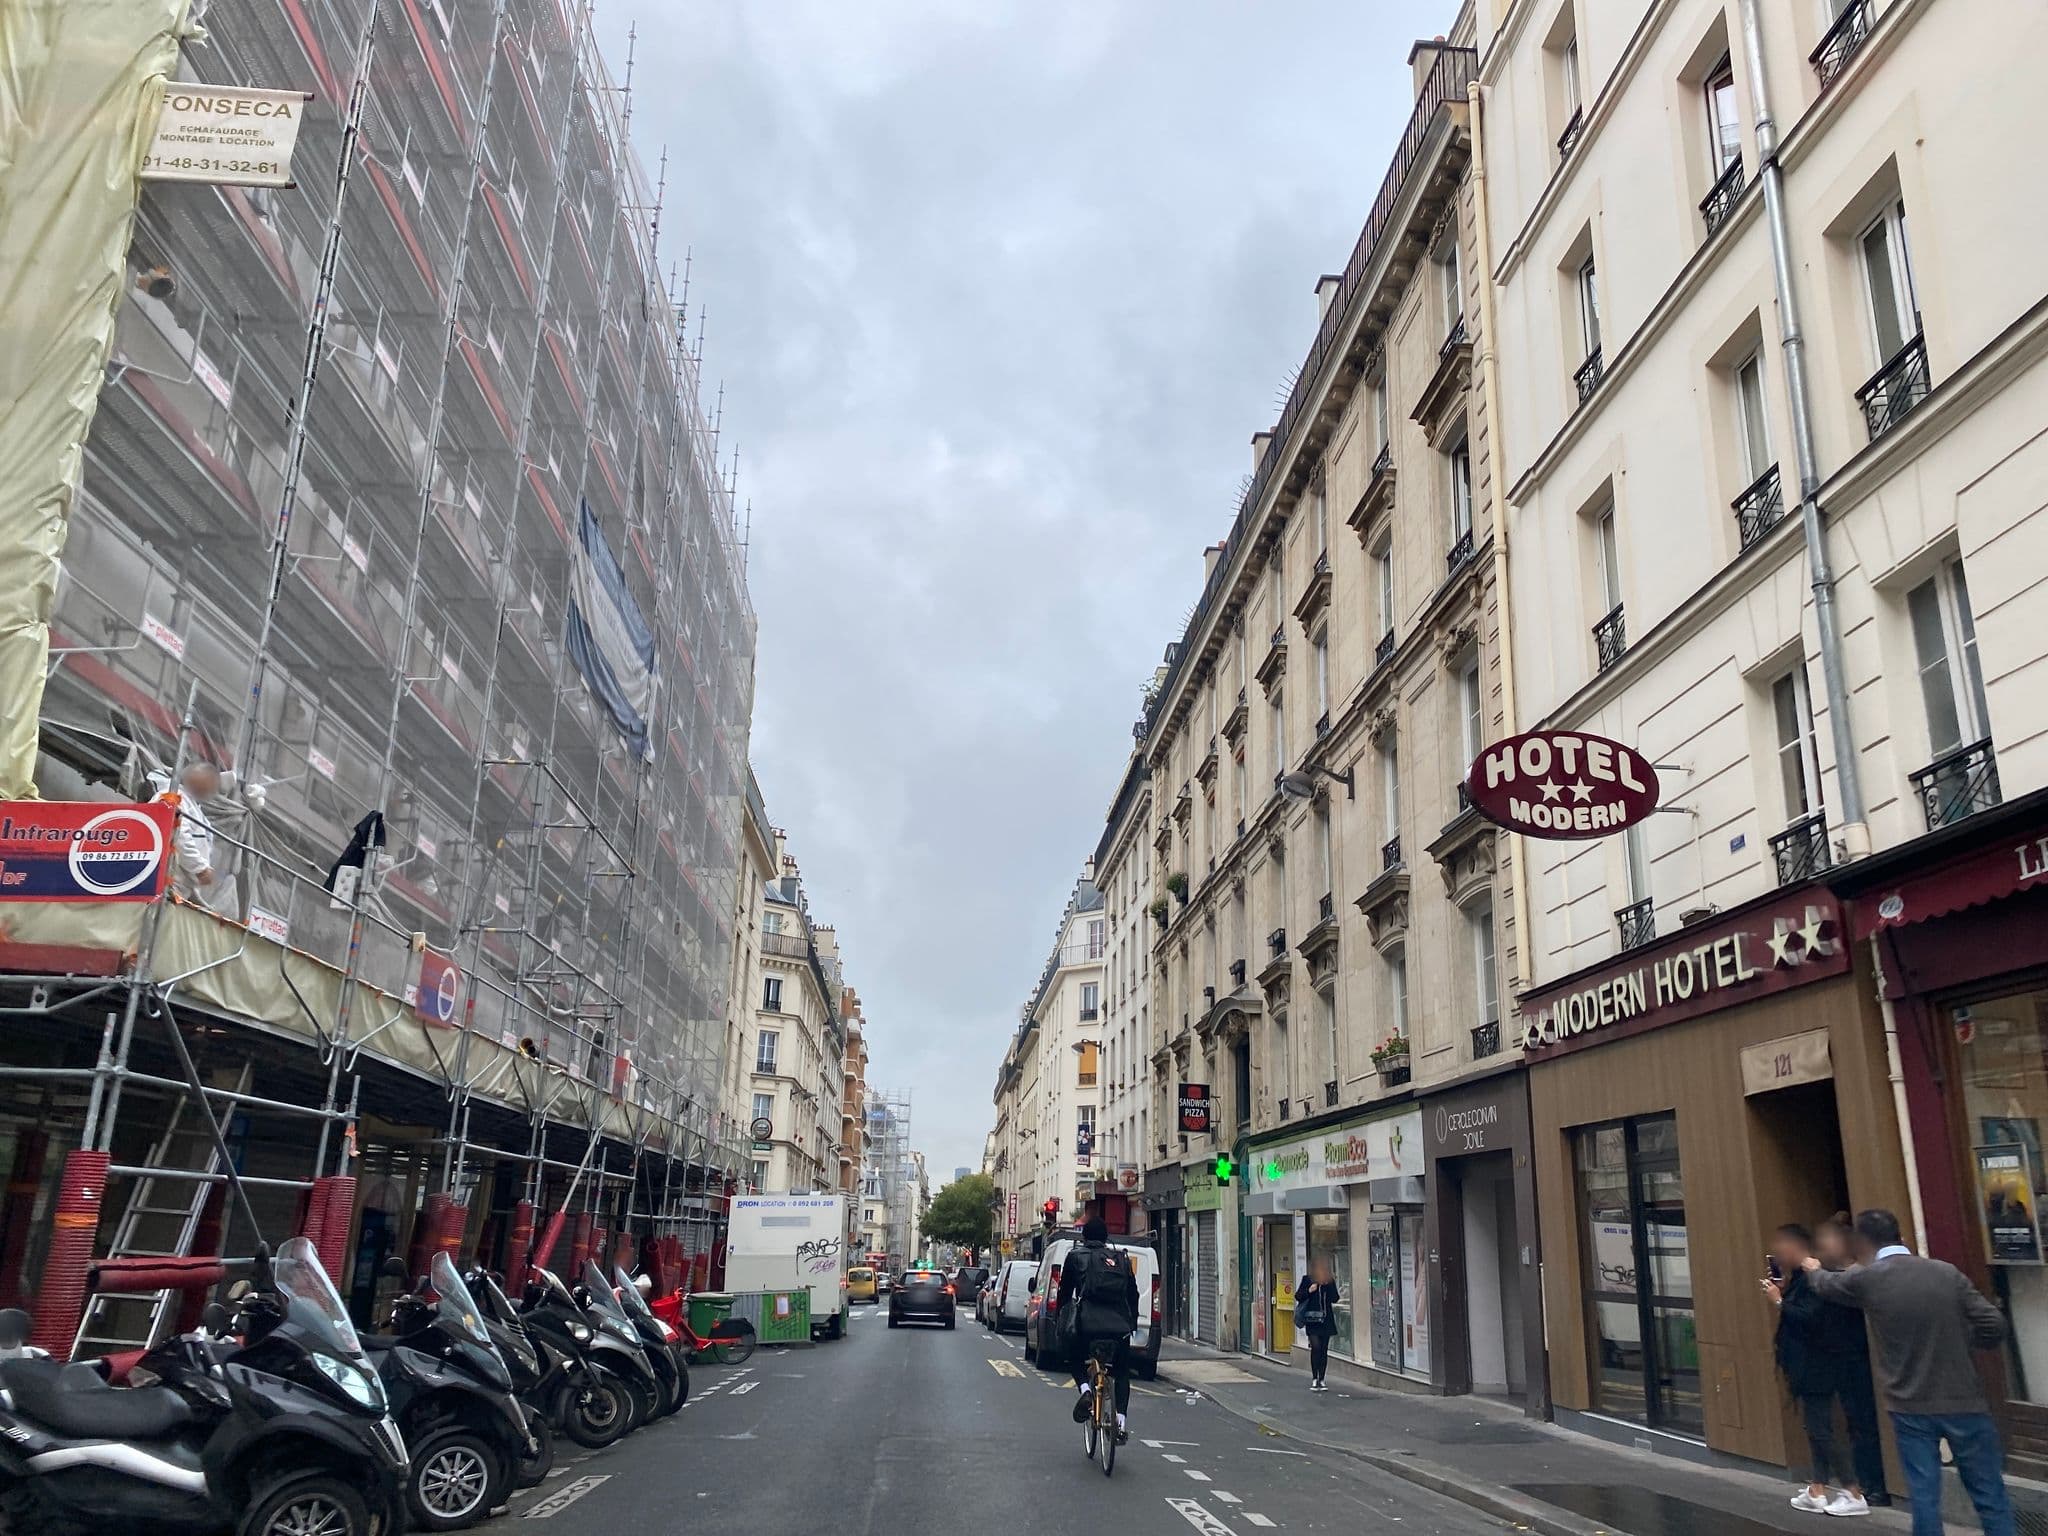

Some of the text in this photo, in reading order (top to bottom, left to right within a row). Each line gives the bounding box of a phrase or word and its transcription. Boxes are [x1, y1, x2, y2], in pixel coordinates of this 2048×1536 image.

[159, 134, 275, 147] MONTAGE LOCATION
[179, 125, 260, 137] ECHAFAUDAGE
[1485, 736, 1646, 794] HOTEL
[1509, 797, 1627, 831] MODERN
[1, 816, 129, 845] Infrarouge
[82, 852, 94, 861] 09
[95, 852, 107, 861] 86
[109, 852, 121, 860] 72
[1553, 932, 1754, 1040] MODERN HOTEL
[1773, 1053, 1793, 1078] 121
[1179, 1097, 1210, 1108] SANDWICH
[1184, 1108, 1205, 1118] PIZZA
